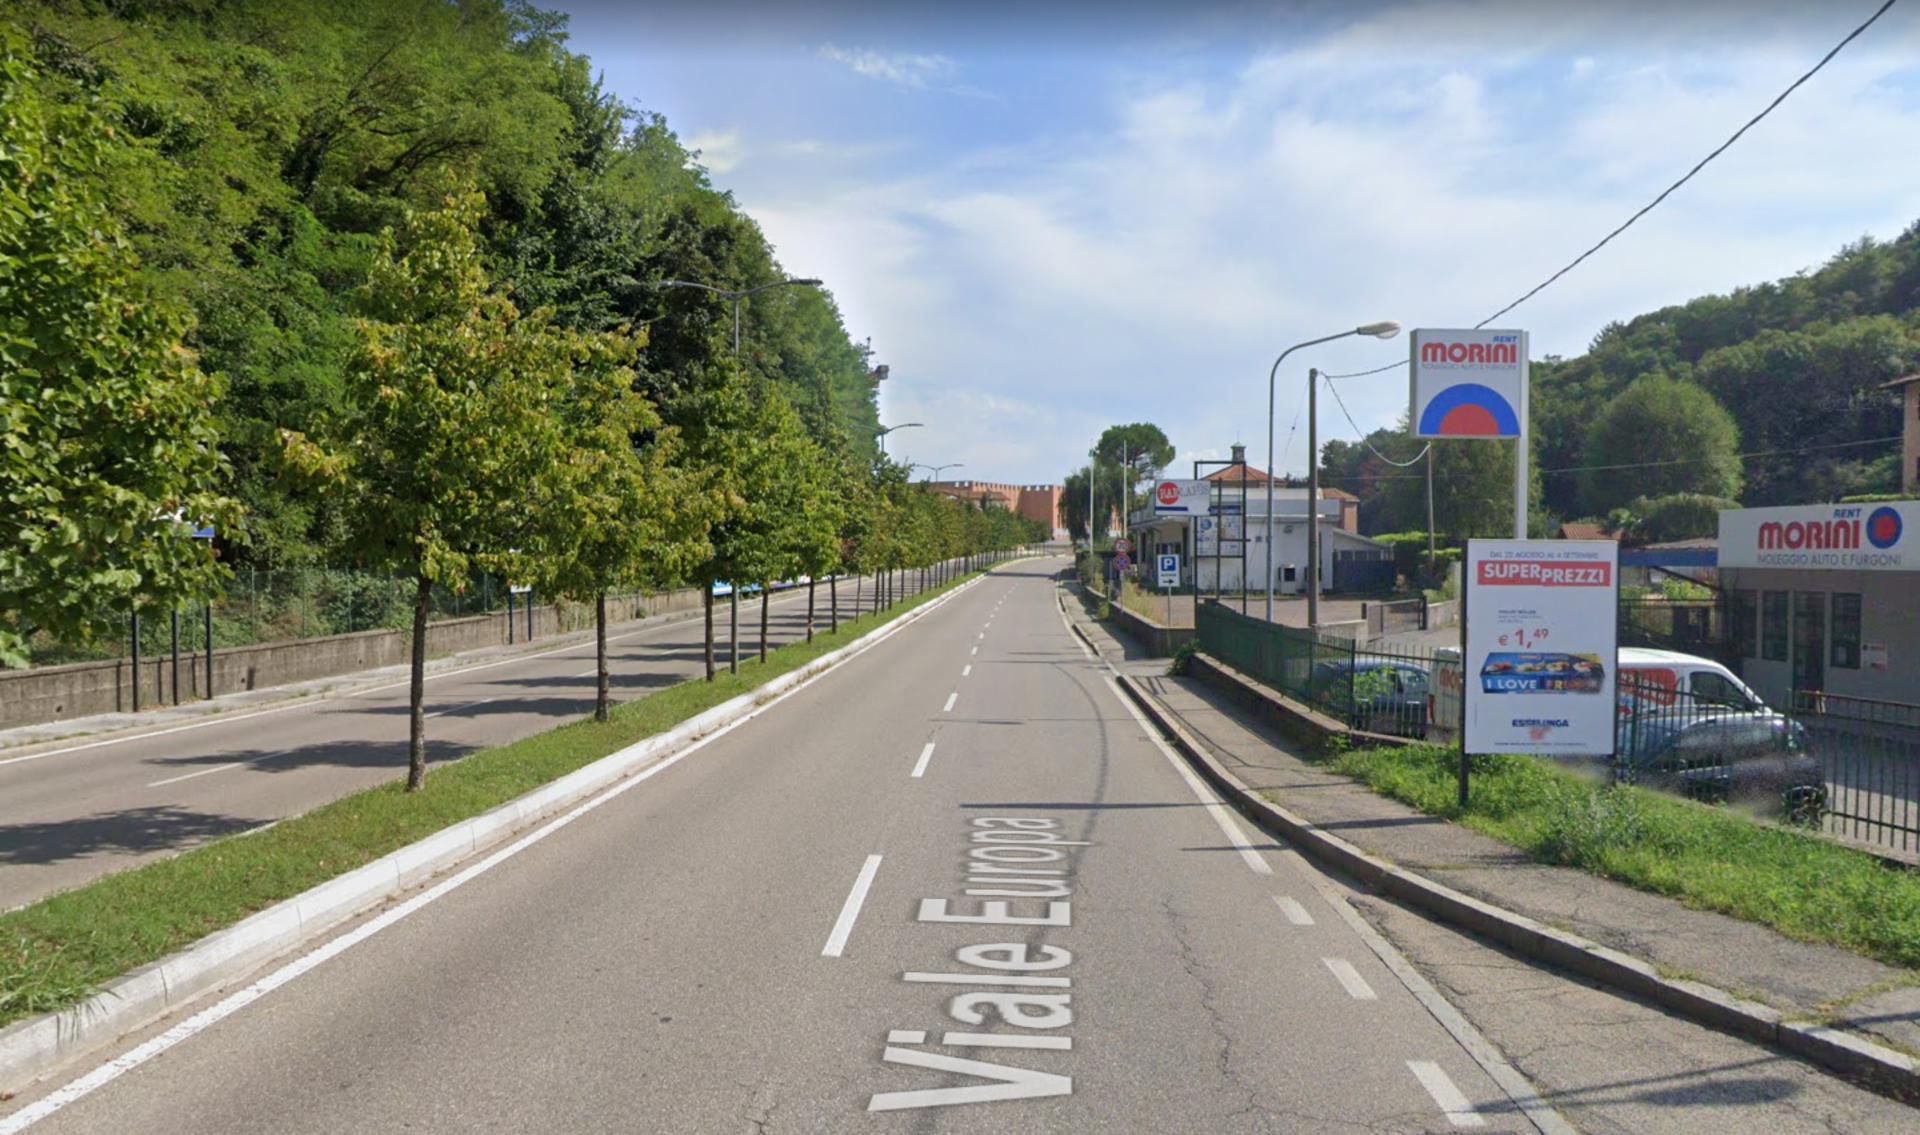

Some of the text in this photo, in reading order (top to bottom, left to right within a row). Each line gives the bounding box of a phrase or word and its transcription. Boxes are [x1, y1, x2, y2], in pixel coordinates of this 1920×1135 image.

[1422, 342, 1517, 363] MORINI
[1833, 508, 1862, 518] RENT
[1758, 520, 1861, 549] MORINI
[1758, 553, 1901, 566] NOLEGGIO AUTO E FURGONI
[1499, 679, 1536, 689] LOVE
